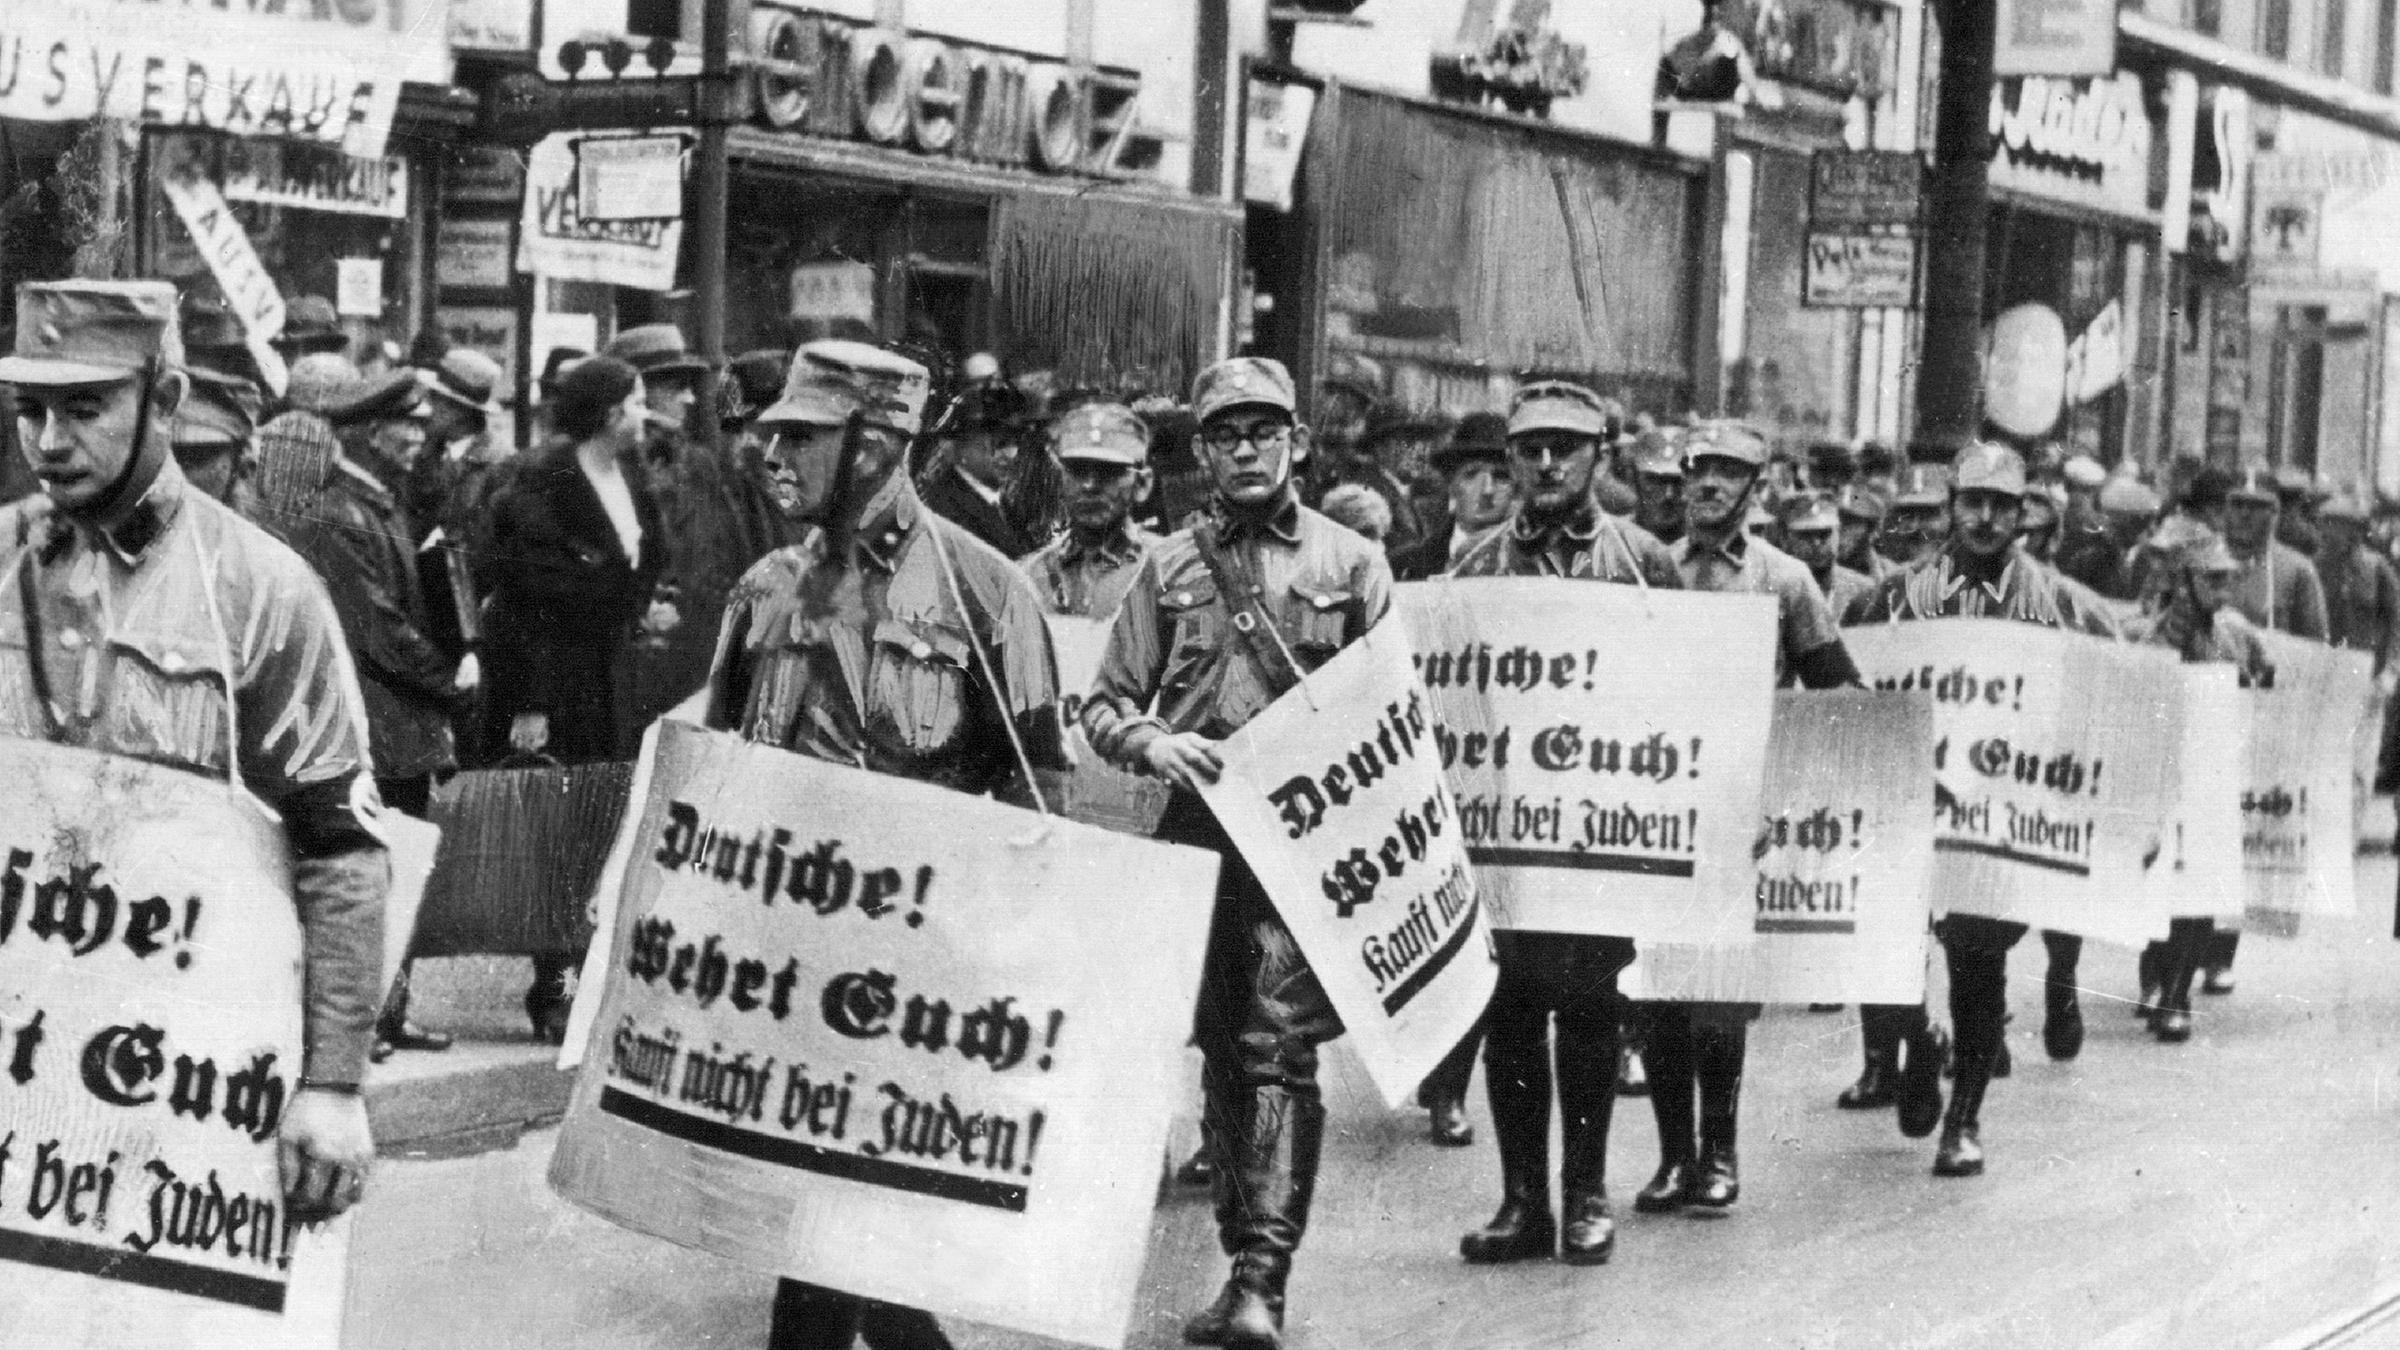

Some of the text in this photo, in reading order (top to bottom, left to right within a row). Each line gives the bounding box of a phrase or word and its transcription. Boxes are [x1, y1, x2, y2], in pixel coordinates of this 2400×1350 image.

[1531, 724, 1702, 783] Euch!
[1969, 737, 2102, 796] Euch!
[656, 800, 934, 929] Deutsche!
[1511, 793, 1561, 845] bei
[1571, 798, 1698, 854] Juden!
[2001, 800, 2094, 858] Juden!
[1362, 892, 1438, 993] Kauft
[629, 915, 1064, 1072] Wehrt Euch!
[680, 1041, 775, 1122] nicht
[779, 1062, 856, 1139] bei
[859, 1081, 1046, 1176] Juden!
[27, 1139, 121, 1232] bei
